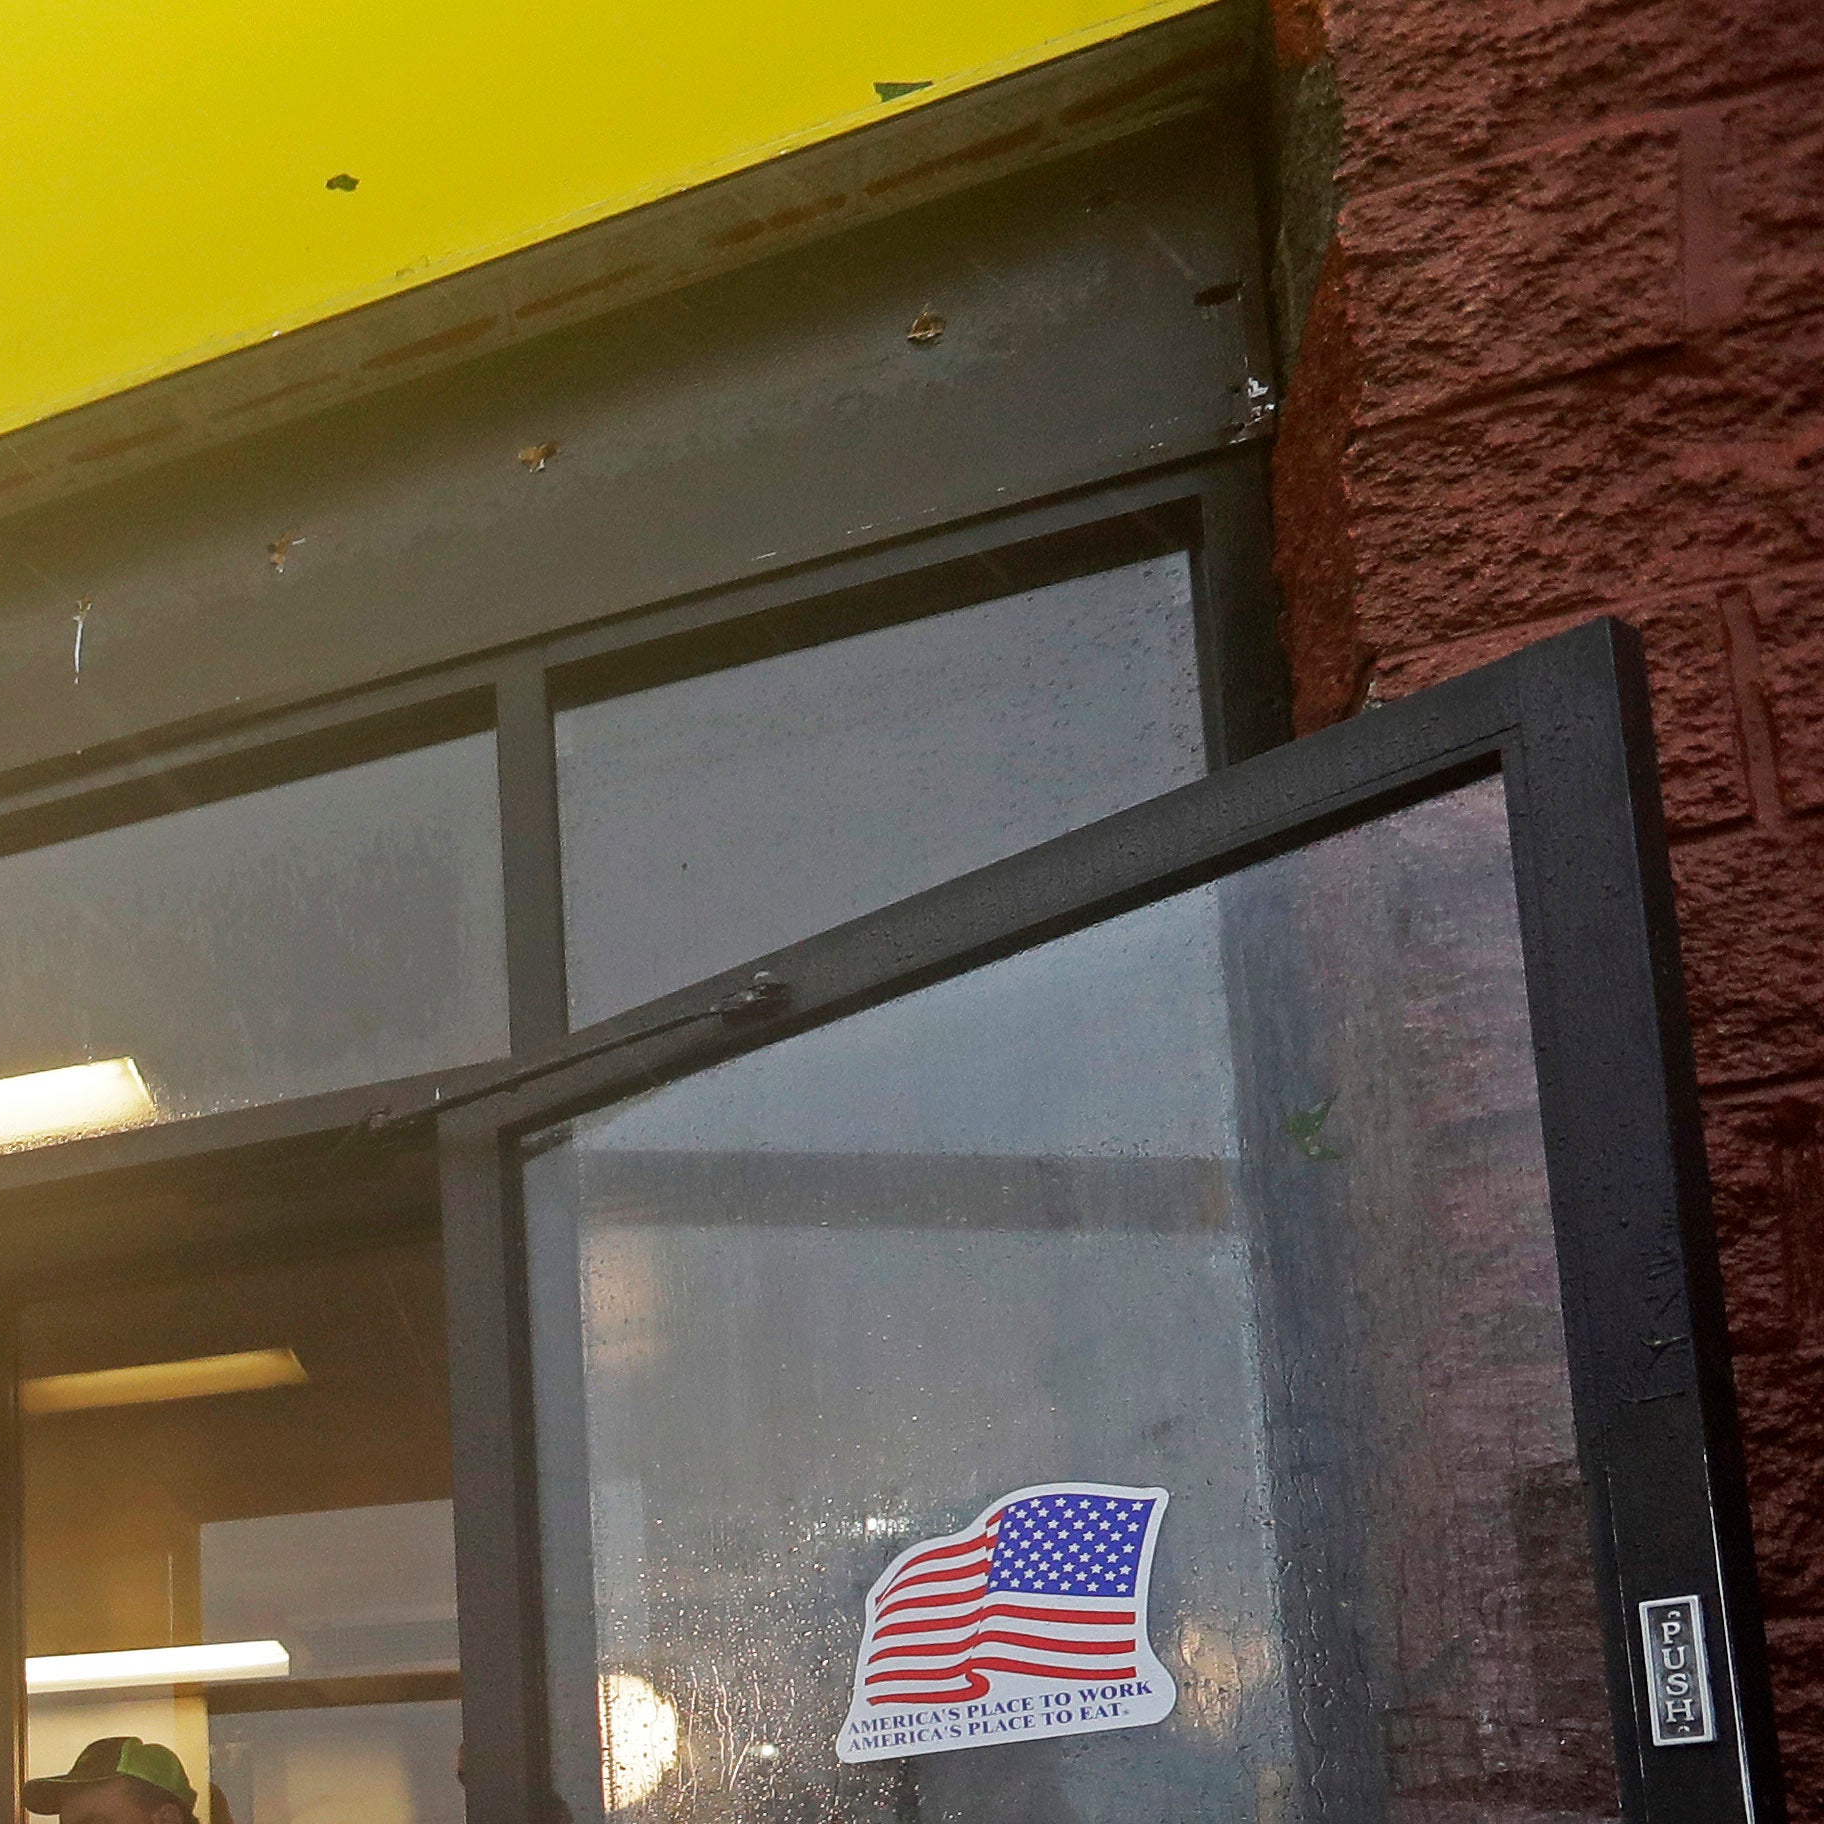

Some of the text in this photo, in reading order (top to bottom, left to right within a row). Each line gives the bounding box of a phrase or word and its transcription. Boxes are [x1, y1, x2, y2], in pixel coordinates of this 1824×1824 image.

[1660, 1621, 1695, 1723] PUSH
[848, 1680, 1152, 1735] AMERICA'S PLACE TO WORK
[849, 1724, 961, 1751] AMERICA'S
[968, 1714, 1036, 1736] PLACE
[1042, 1709, 1072, 1725] TO
